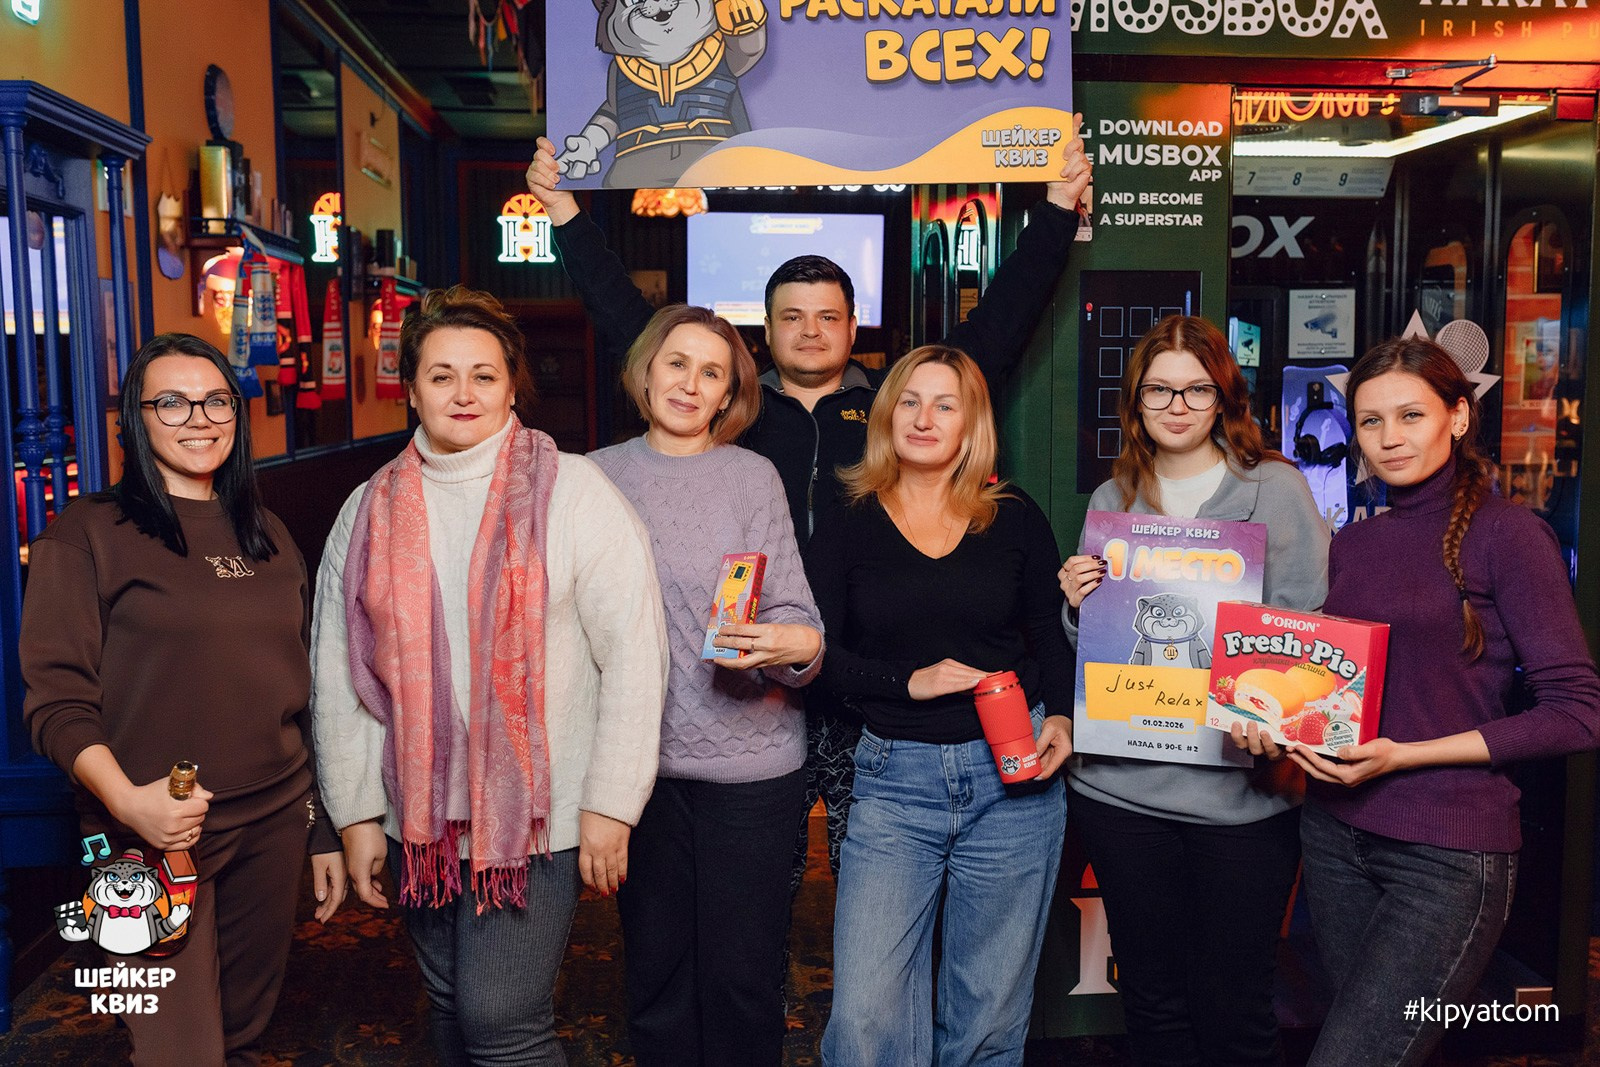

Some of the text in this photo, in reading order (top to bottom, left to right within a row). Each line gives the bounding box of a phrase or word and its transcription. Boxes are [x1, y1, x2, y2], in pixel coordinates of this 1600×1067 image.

[1420, 18, 1532, 38] IRISH
[865, 27, 1051, 83] ВСЕХ!
[1100, 119, 1223, 136] DOWNLOAD
[982, 124, 1061, 147] ШЕЙКЕР
[994, 149, 1048, 167] КВИЗ
[1099, 144, 1222, 166] MUSBOX
[1189, 169, 1222, 181] APP
[1247, 171, 1256, 185] 7
[1292, 171, 1302, 185] 8
[1338, 172, 1348, 186] 9
[1101, 192, 1203, 205] AND BECOME
[1100, 214, 1203, 226] A SUPERSTAR
[1132, 523, 1220, 539] ШЕЙКЕР КВИЗ
[1106, 541, 1243, 583] 1 МЕСТО
[1155, 691, 1203, 706] Relax
[1142, 719, 1185, 729] 01.02.2026
[1210, 717, 1219, 726] 12
[1128, 740, 1154, 749] НАЗАД
[1165, 743, 1182, 751] 90-Е
